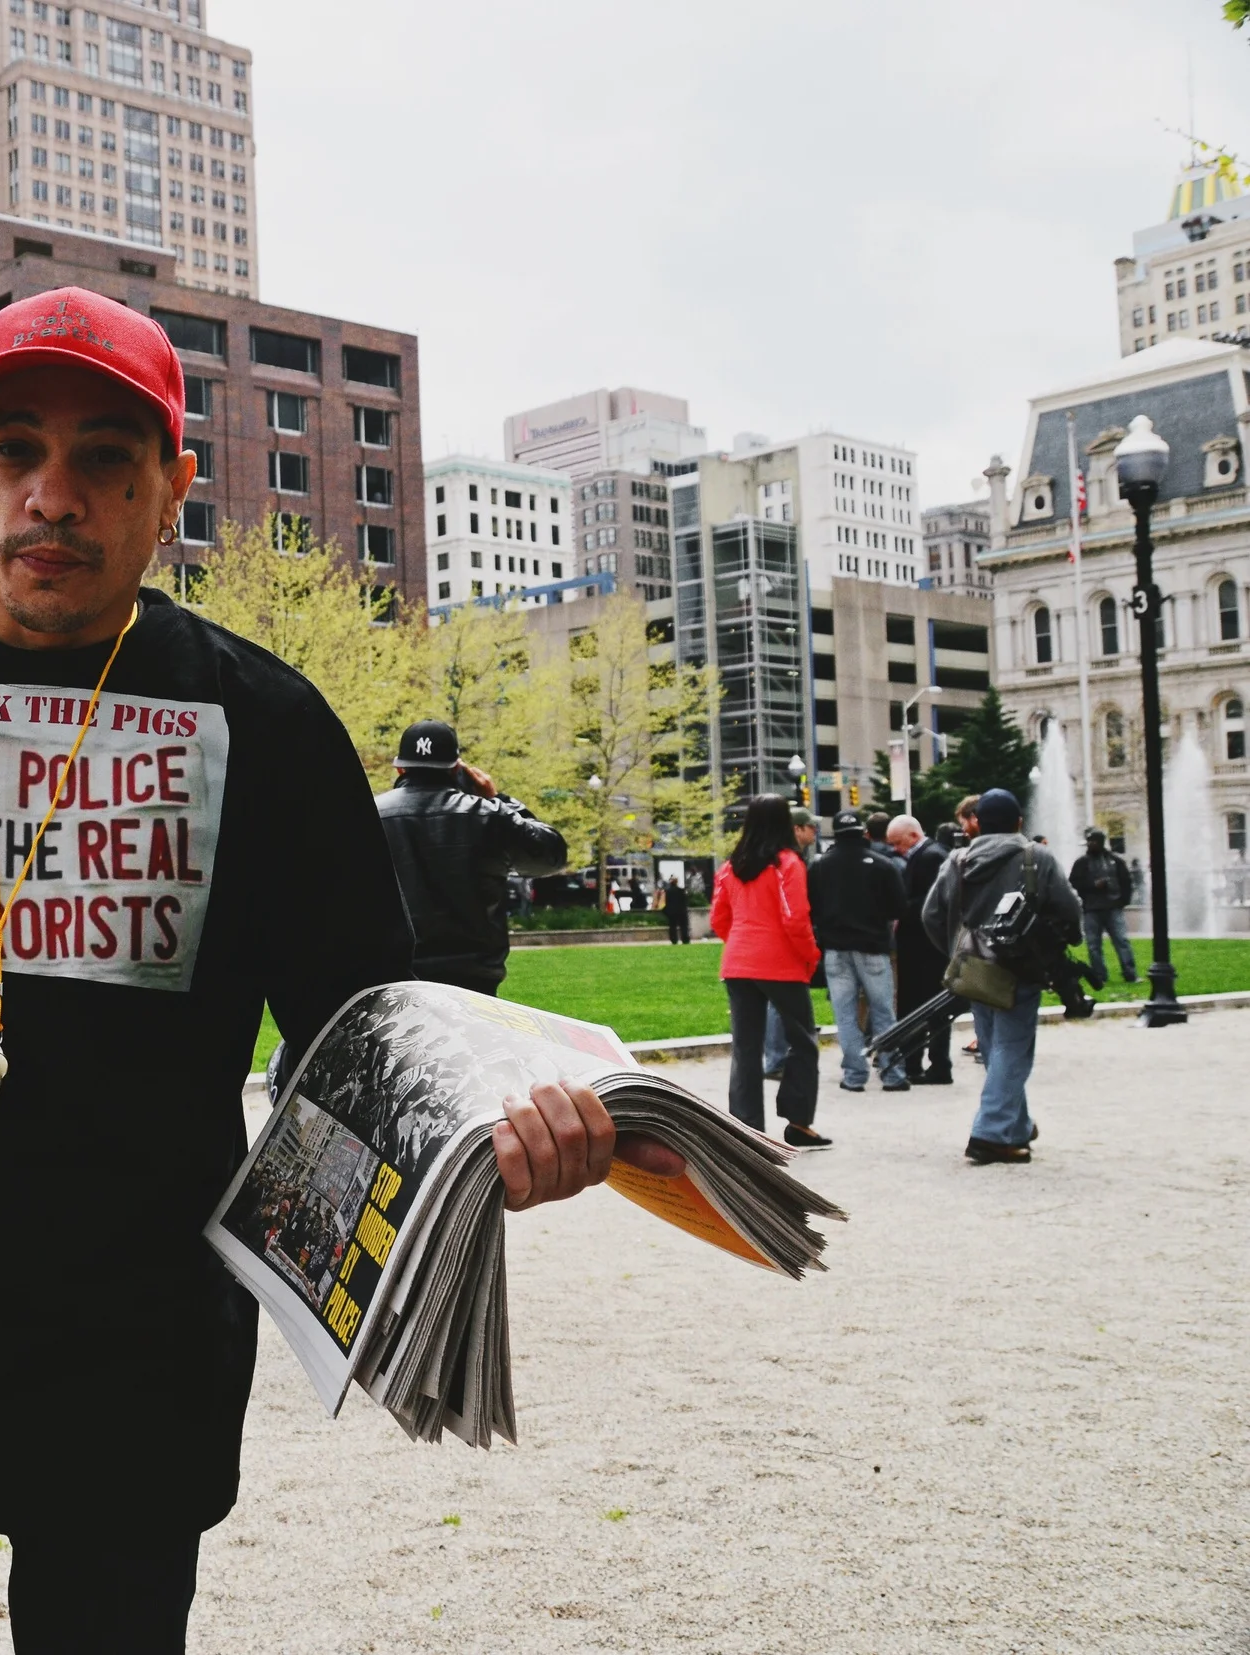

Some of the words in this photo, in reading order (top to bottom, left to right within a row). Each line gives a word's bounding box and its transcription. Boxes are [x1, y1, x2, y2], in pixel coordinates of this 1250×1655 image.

[31, 312, 90, 327] Can't
[54, 301, 68, 312] I
[13, 327, 114, 351] Breathe
[1134, 590, 1149, 614] 3
[25, 694, 99, 727] THE
[111, 704, 198, 737] PIGS
[416, 736, 432, 756] NY
[18, 747, 190, 809] POLICE
[78, 817, 203, 883] REAL
[371, 1162, 403, 1212] STOP
[355, 1202, 397, 1269] MURDER
[339, 1241, 362, 1284] BY
[323, 1281, 362, 1347] POLICE!
